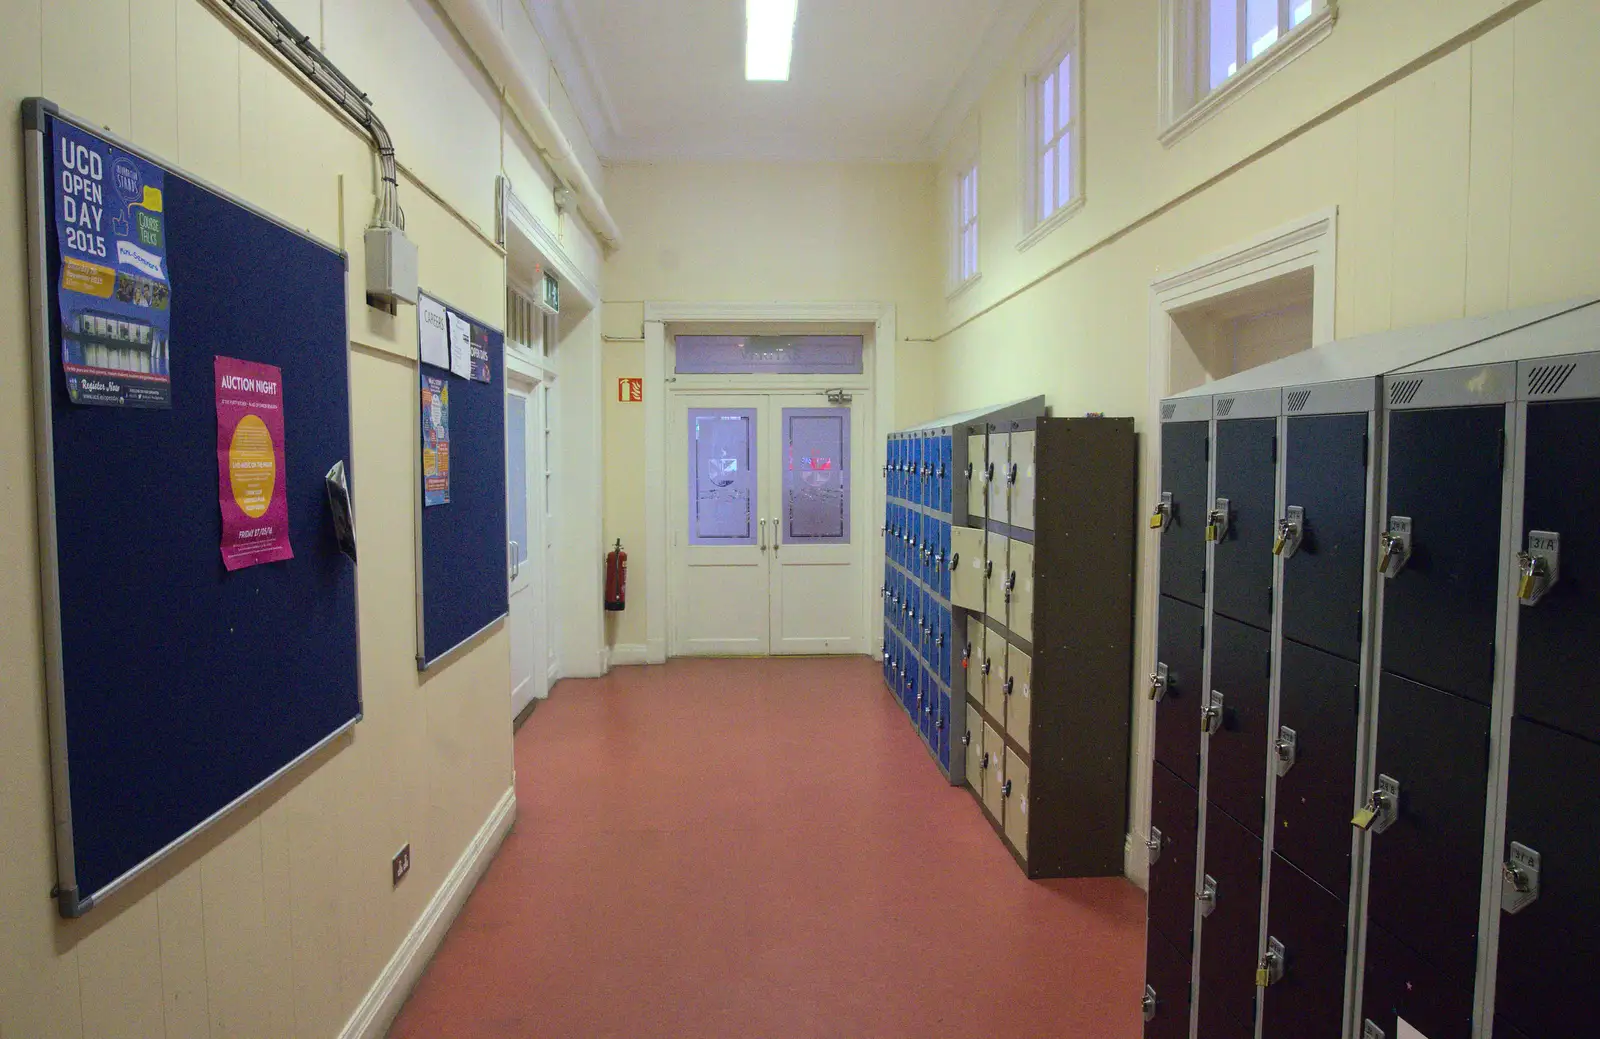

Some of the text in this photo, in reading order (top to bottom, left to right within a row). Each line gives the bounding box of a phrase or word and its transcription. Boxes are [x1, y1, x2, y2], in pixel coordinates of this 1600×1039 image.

[62, 137, 103, 180] UCD
[62, 170, 103, 205] OPEN
[63, 195, 103, 232] DAY
[66, 226, 106, 257] 2015
[140, 227, 158, 246] TALKS
[424, 309, 445, 331] CAREERS
[81, 379, 106, 392] Register
[106, 382, 120, 392] Now
[221, 375, 277, 395] AUCTION NIGHT
